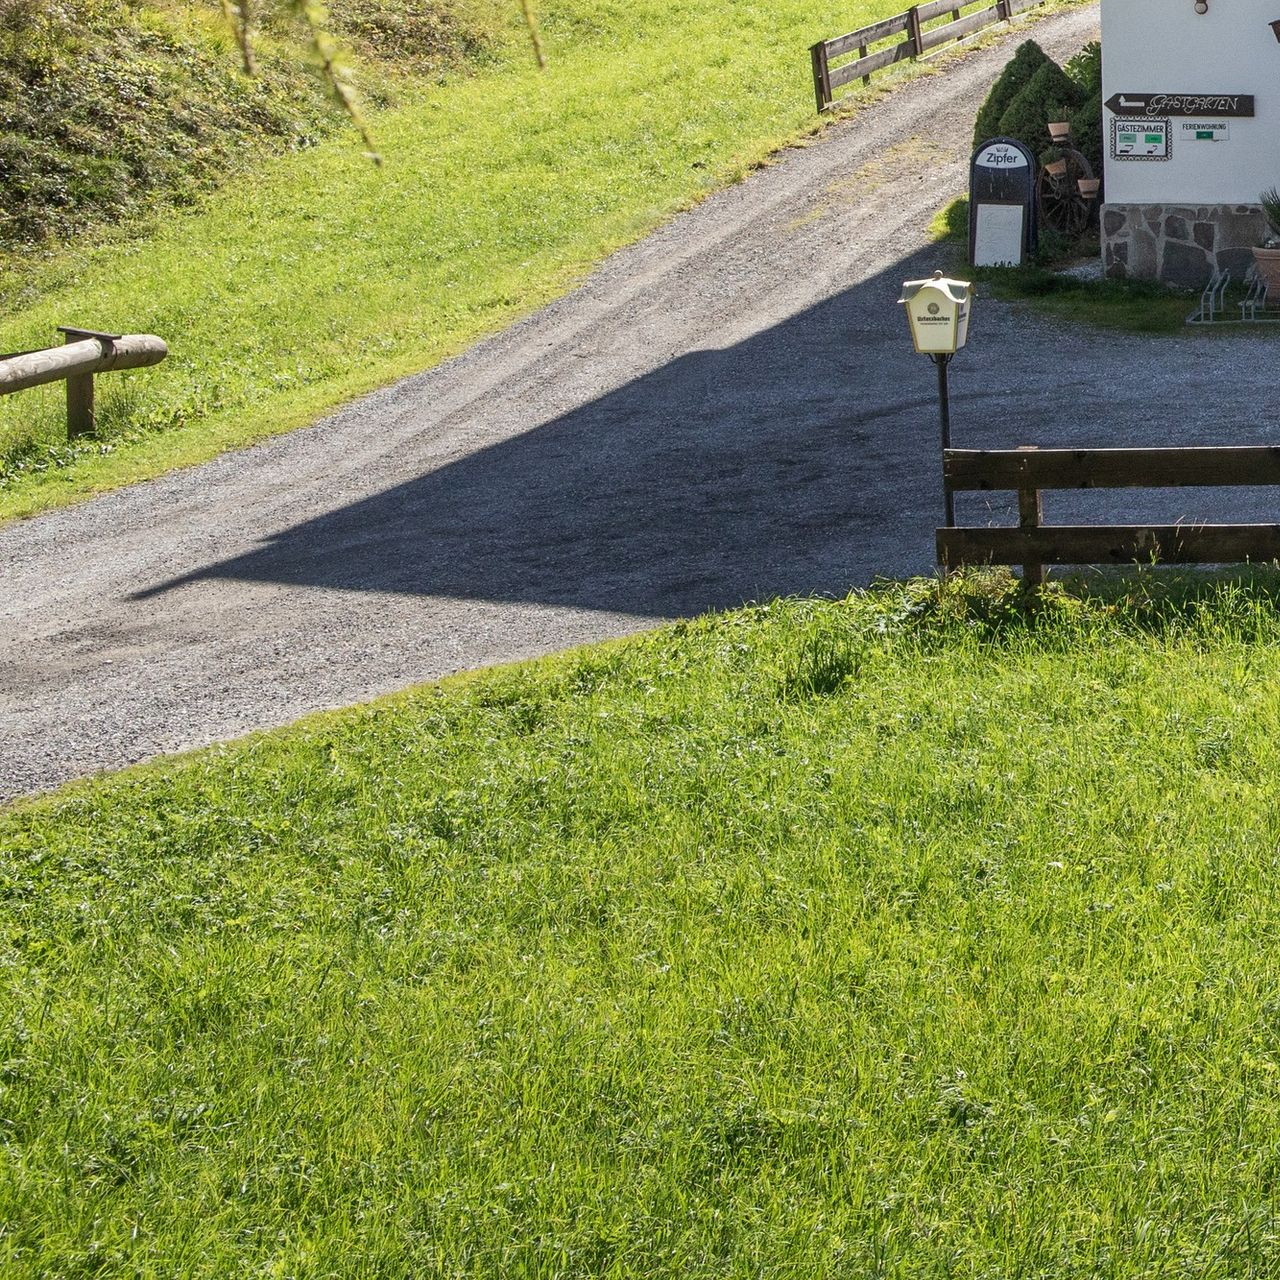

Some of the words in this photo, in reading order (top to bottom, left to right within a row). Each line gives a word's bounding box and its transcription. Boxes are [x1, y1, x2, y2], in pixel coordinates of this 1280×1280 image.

[1146, 95, 1239, 115] GASTGARTEN
[1117, 123, 1164, 133] GÄSTEZIMMER
[1182, 123, 1226, 131] FERIENWOHNUNG
[987, 153, 1018, 166] Zipfer
